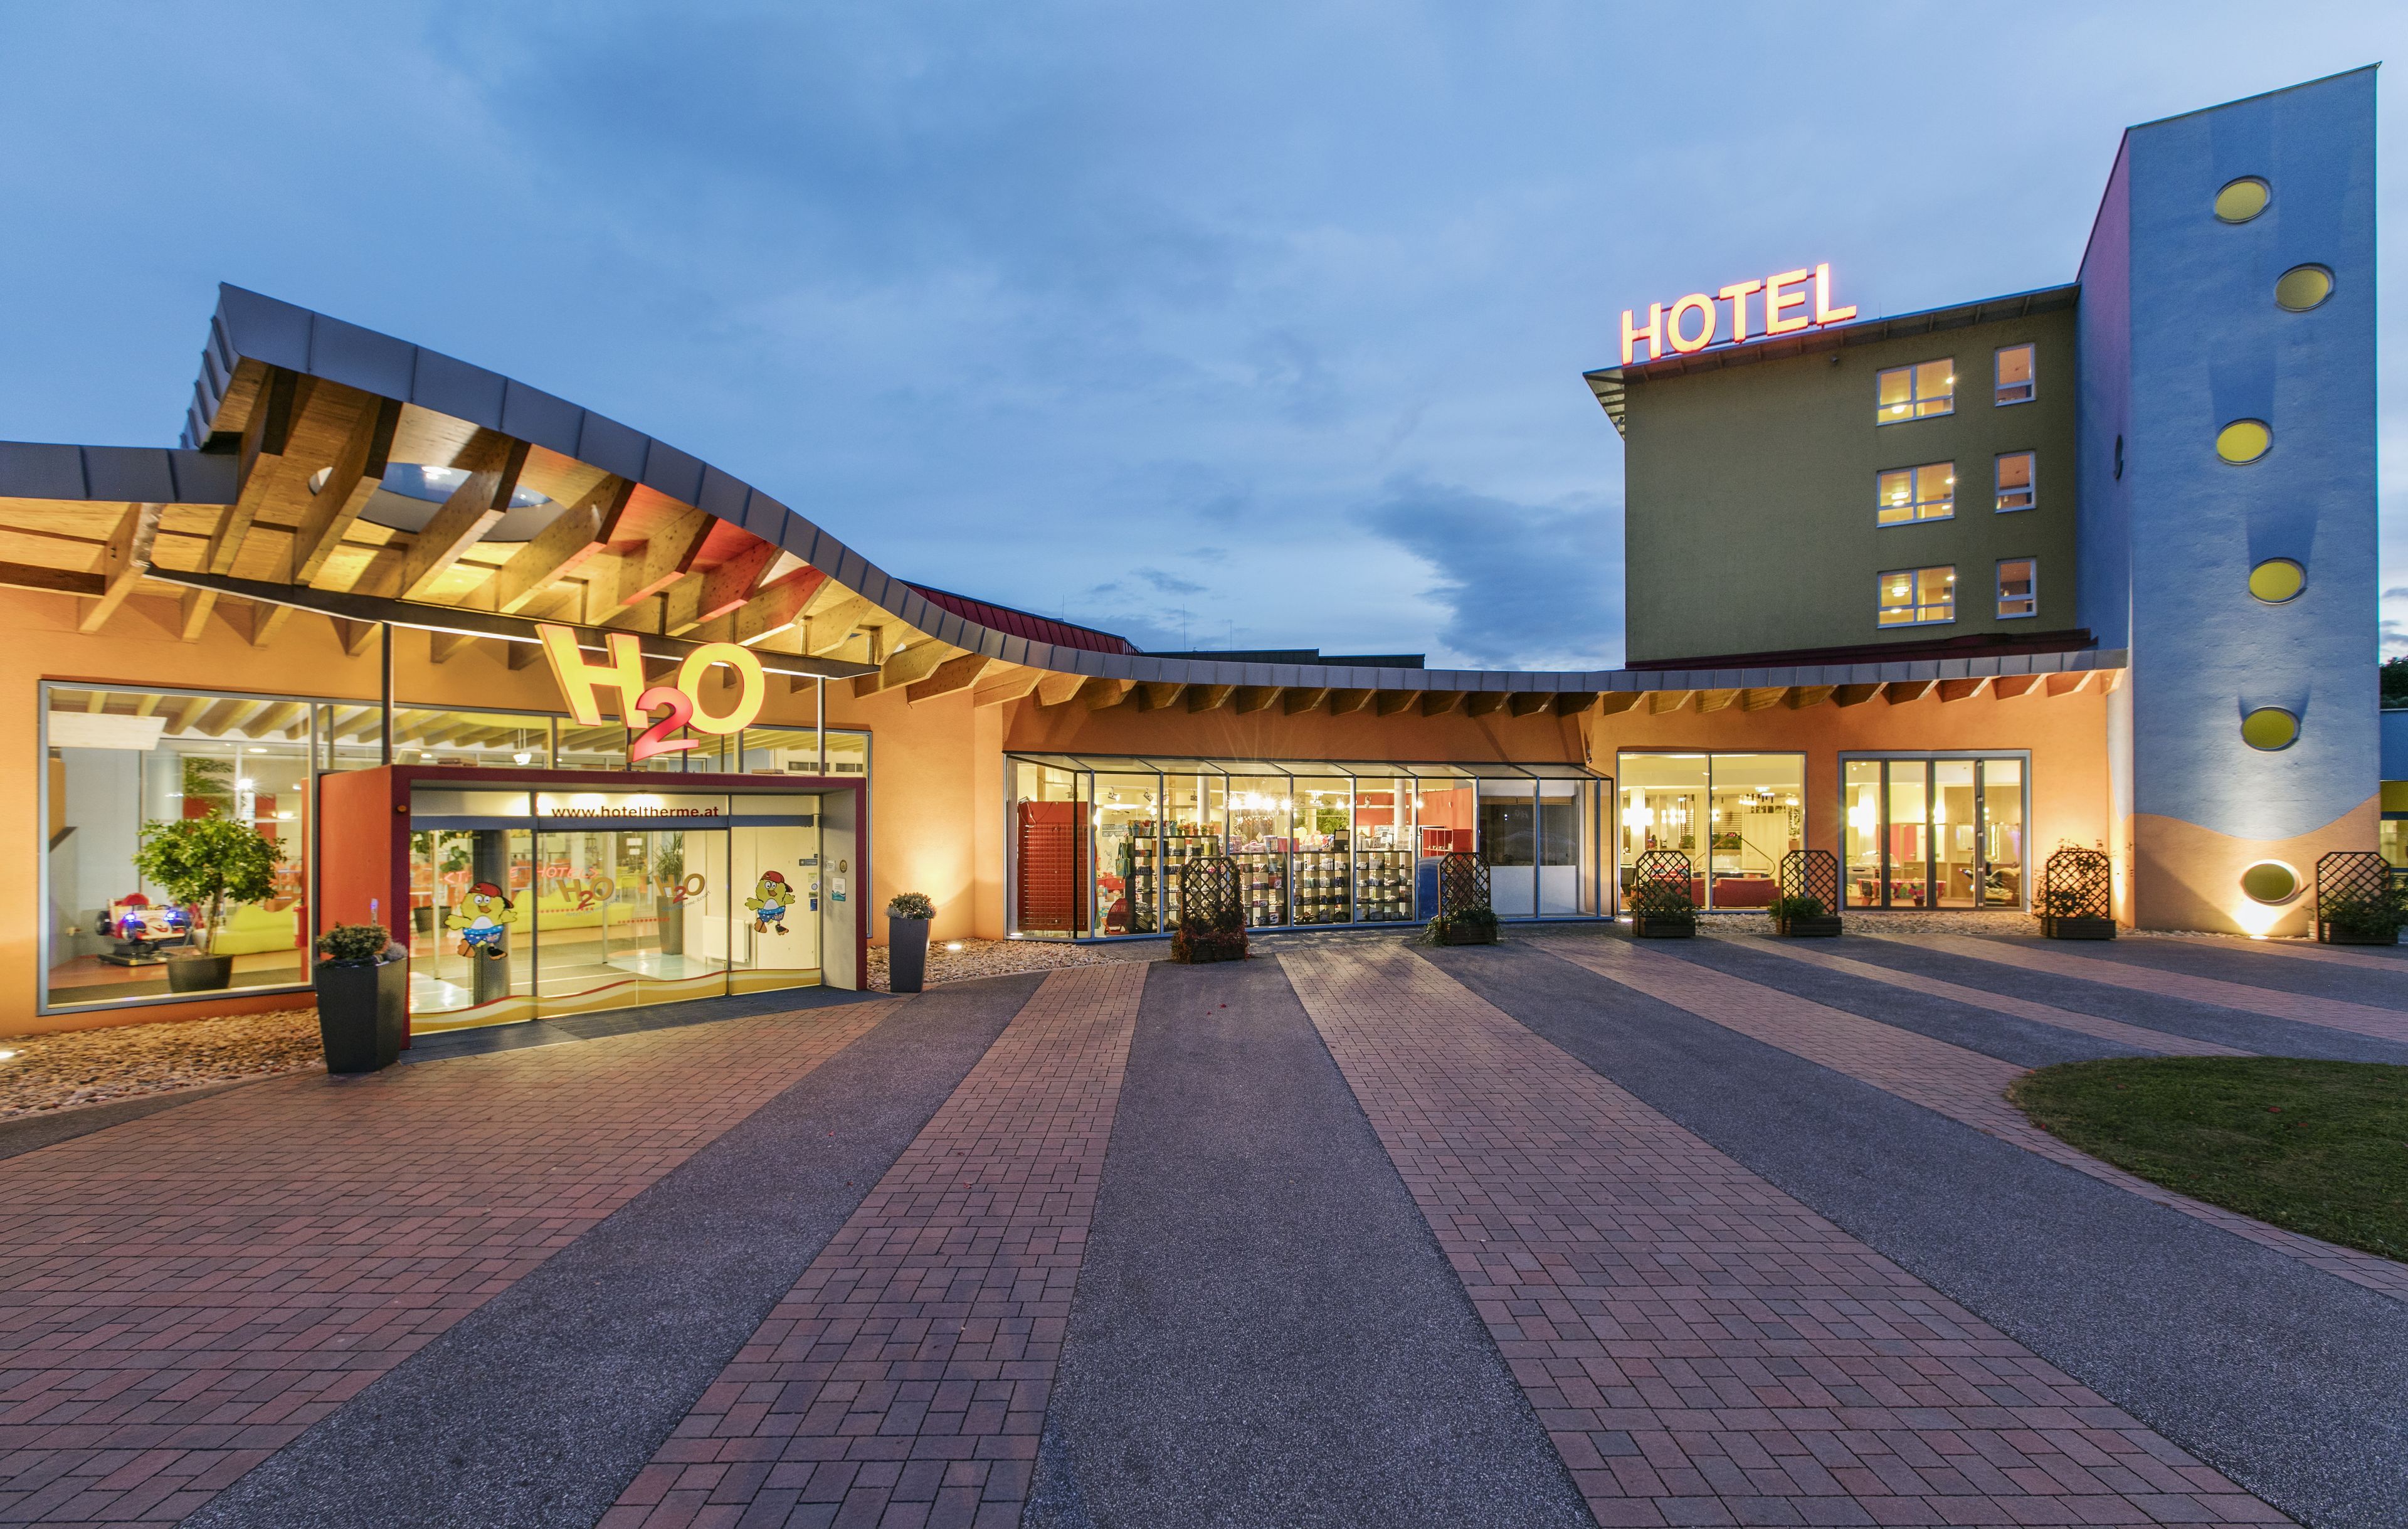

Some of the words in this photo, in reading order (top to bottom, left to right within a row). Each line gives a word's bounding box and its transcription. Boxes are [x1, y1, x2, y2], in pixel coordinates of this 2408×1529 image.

[1622, 263, 1857, 365] HOTEL
[535, 623, 765, 763] H2O
[551, 806, 719, 818] www.hoteltherme.at
[556, 877, 615, 910] H2O
[654, 873, 705, 904] H2O
